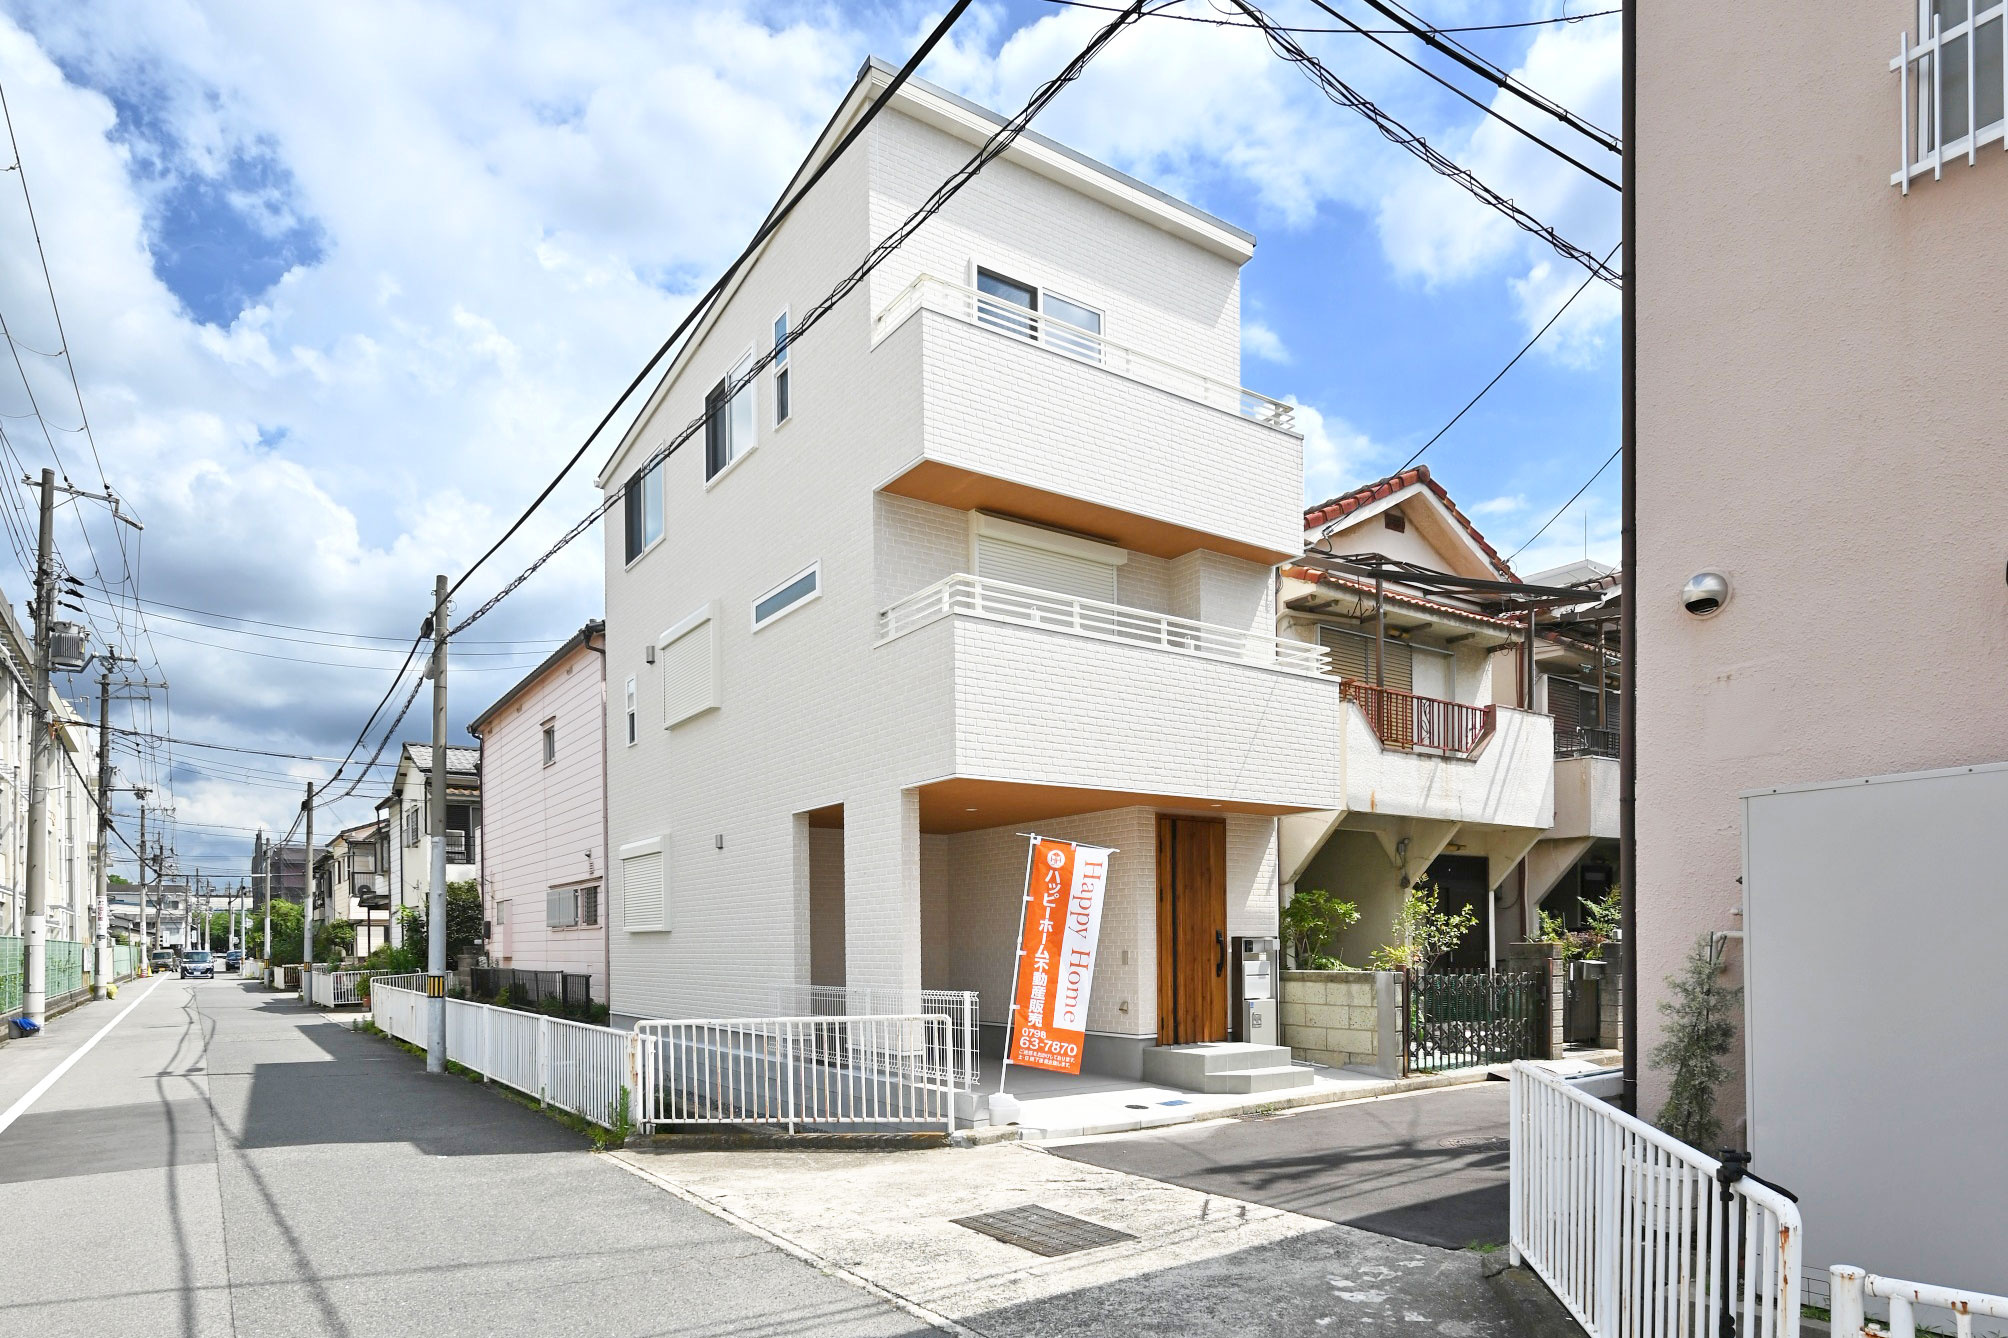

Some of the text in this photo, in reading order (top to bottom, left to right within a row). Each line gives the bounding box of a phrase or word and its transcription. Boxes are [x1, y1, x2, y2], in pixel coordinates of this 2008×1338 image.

[1028, 869, 1061, 1027] ハッピーホーム不動産販売
[1063, 860, 1103, 1023] Happy Home
[1019, 1036, 1077, 1056] 63-7870
[1022, 1028, 1046, 1039] 0798
